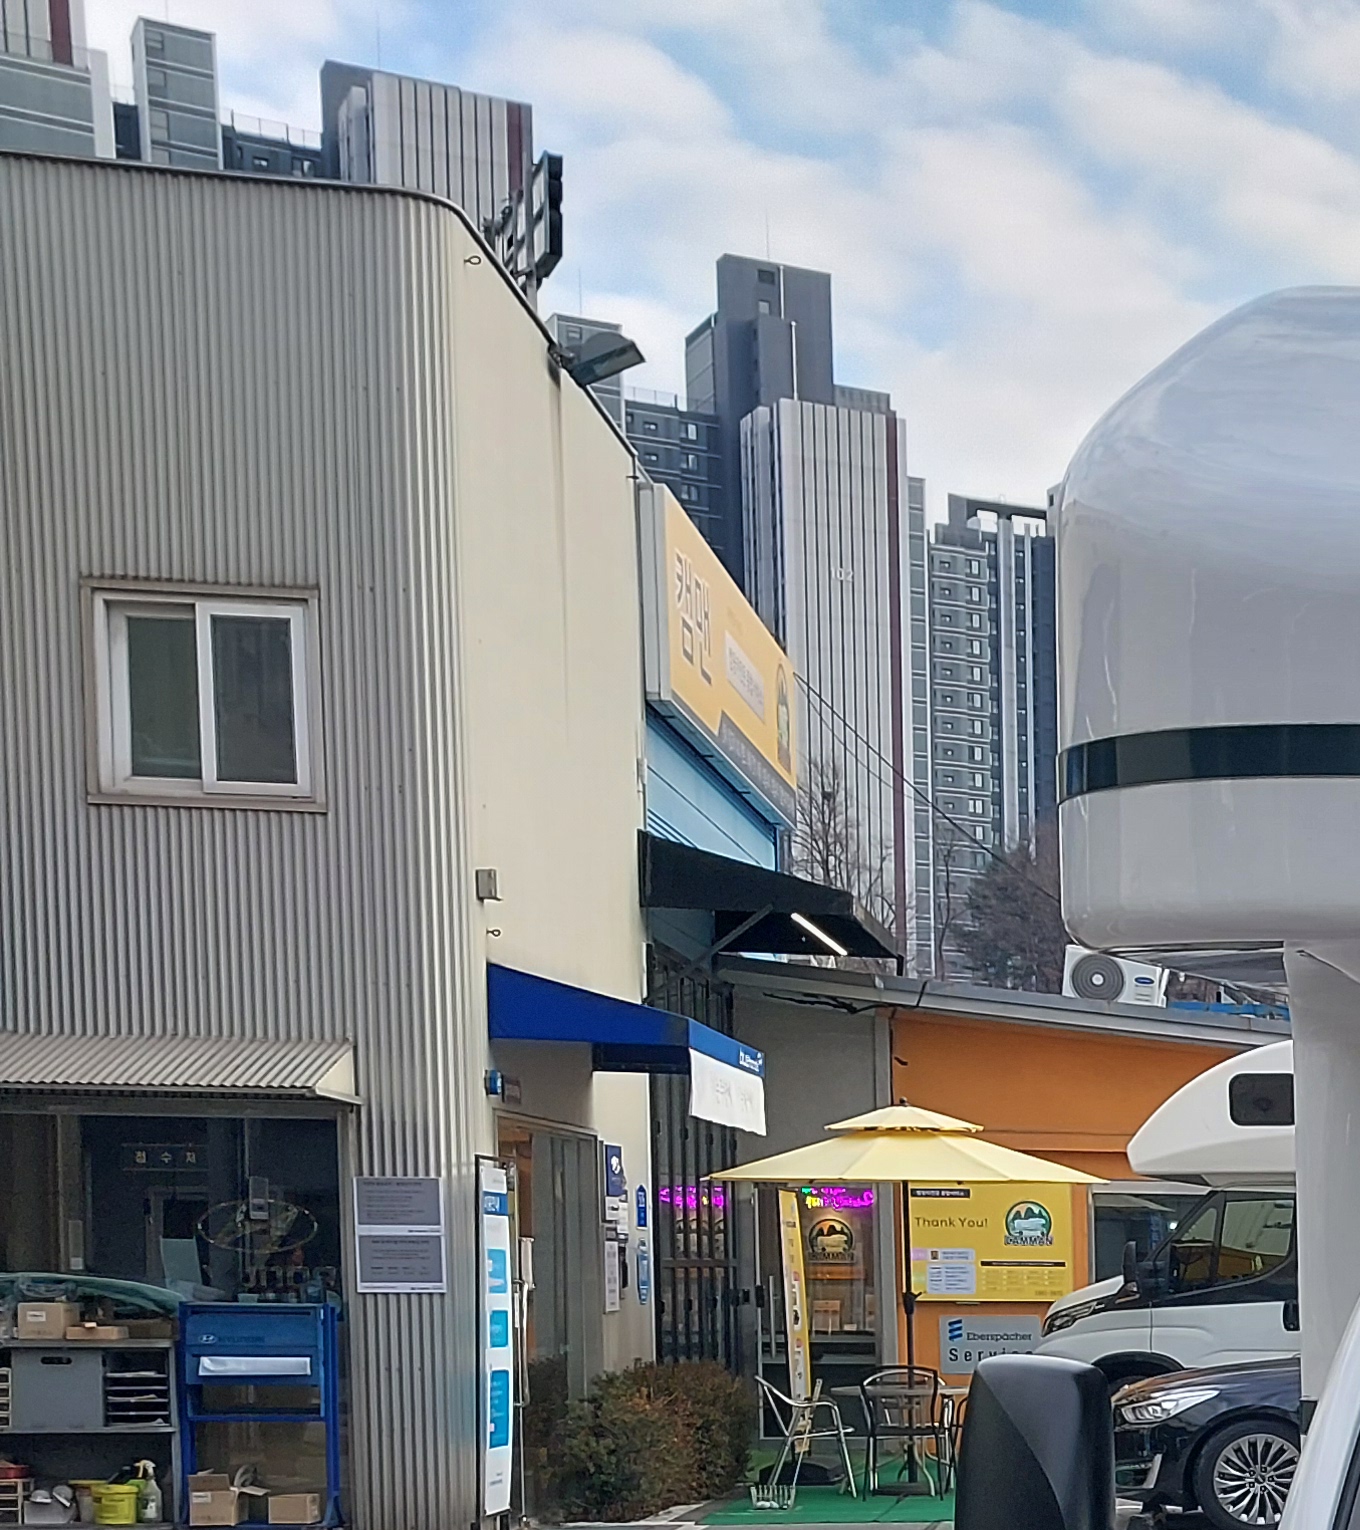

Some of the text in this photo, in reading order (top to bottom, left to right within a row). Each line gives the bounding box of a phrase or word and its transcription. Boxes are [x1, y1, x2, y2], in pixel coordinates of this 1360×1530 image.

[830, 567, 854, 582] 102
[674, 547, 713, 687] 캠맨
[914, 1217, 989, 1228] Thank You!
